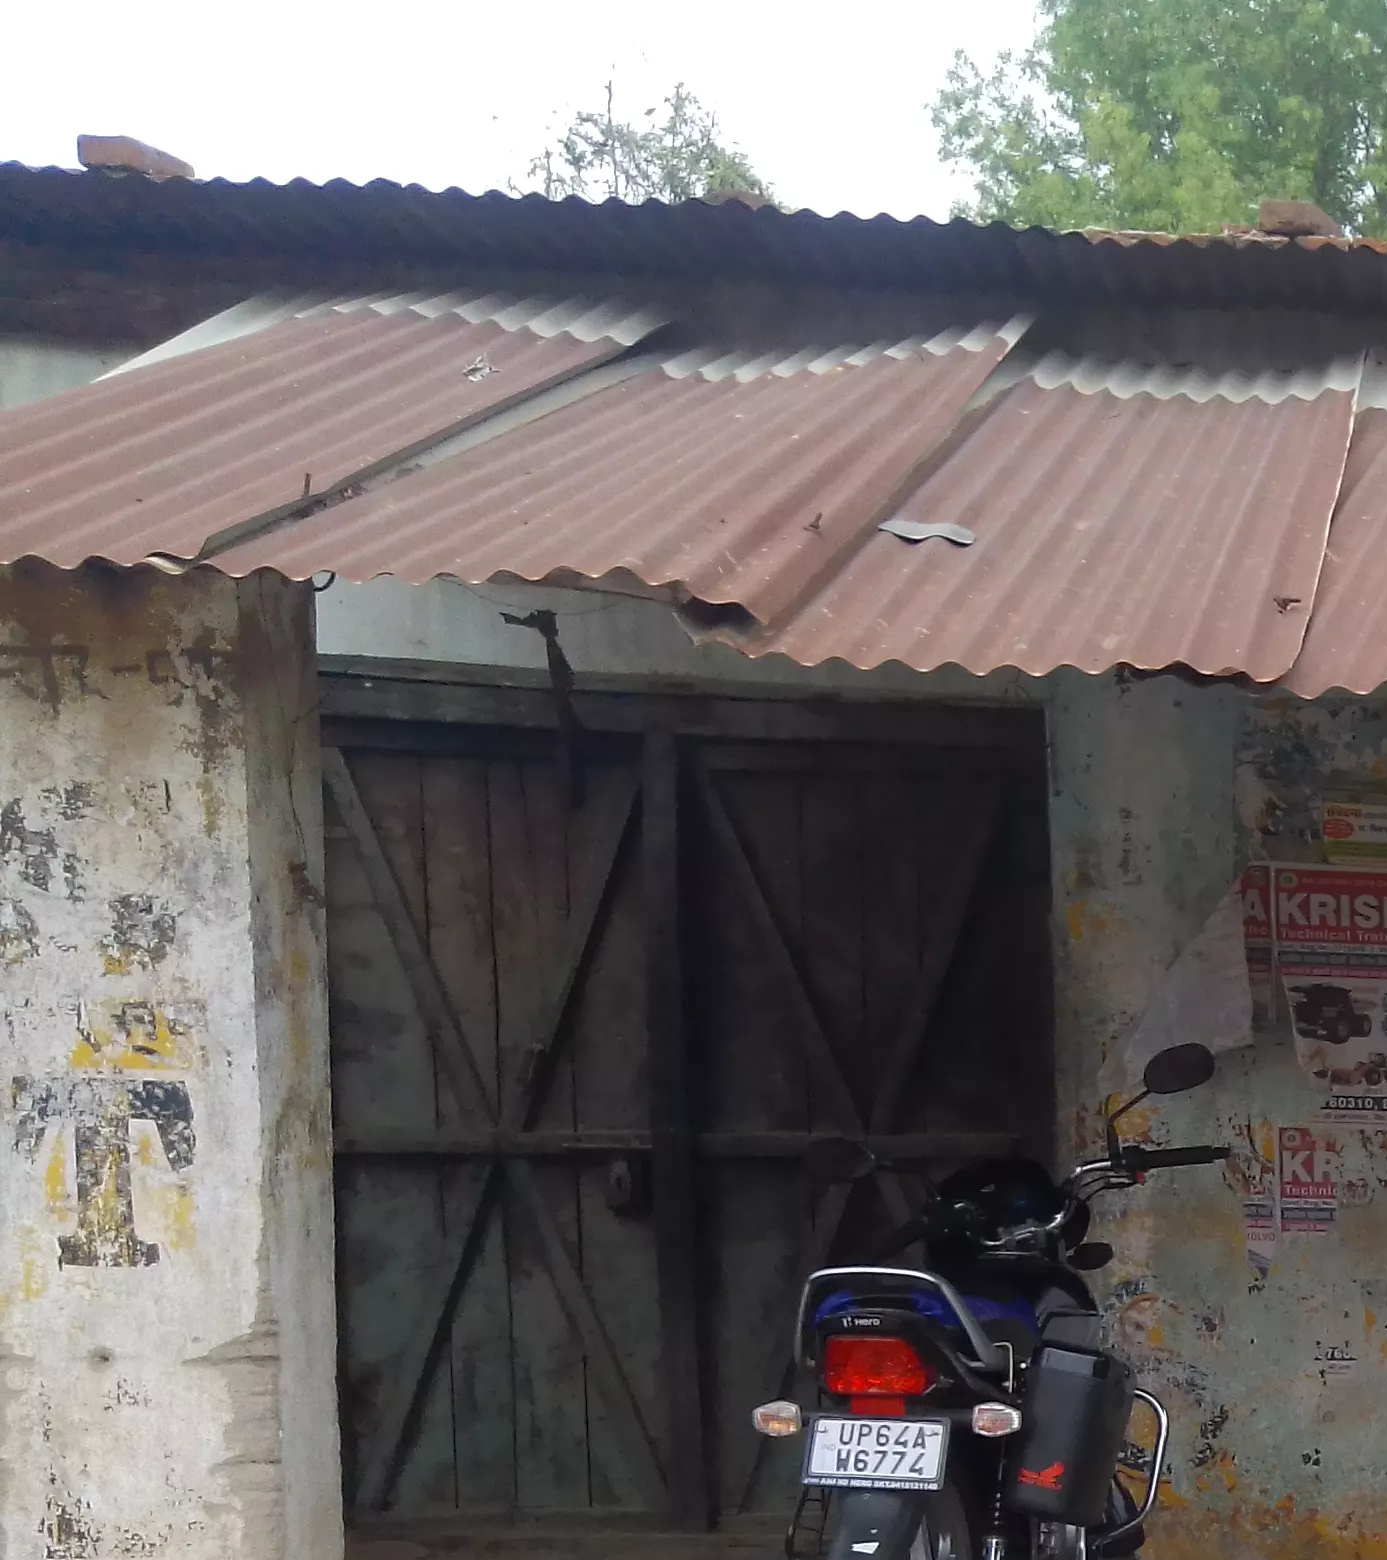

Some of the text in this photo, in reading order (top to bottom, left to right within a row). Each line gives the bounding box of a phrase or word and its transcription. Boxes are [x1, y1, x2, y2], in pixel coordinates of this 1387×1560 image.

[1279, 927, 1352, 943] Technical
[838, 1422, 927, 1450] UP64A
[834, 1448, 926, 1476] W6774
